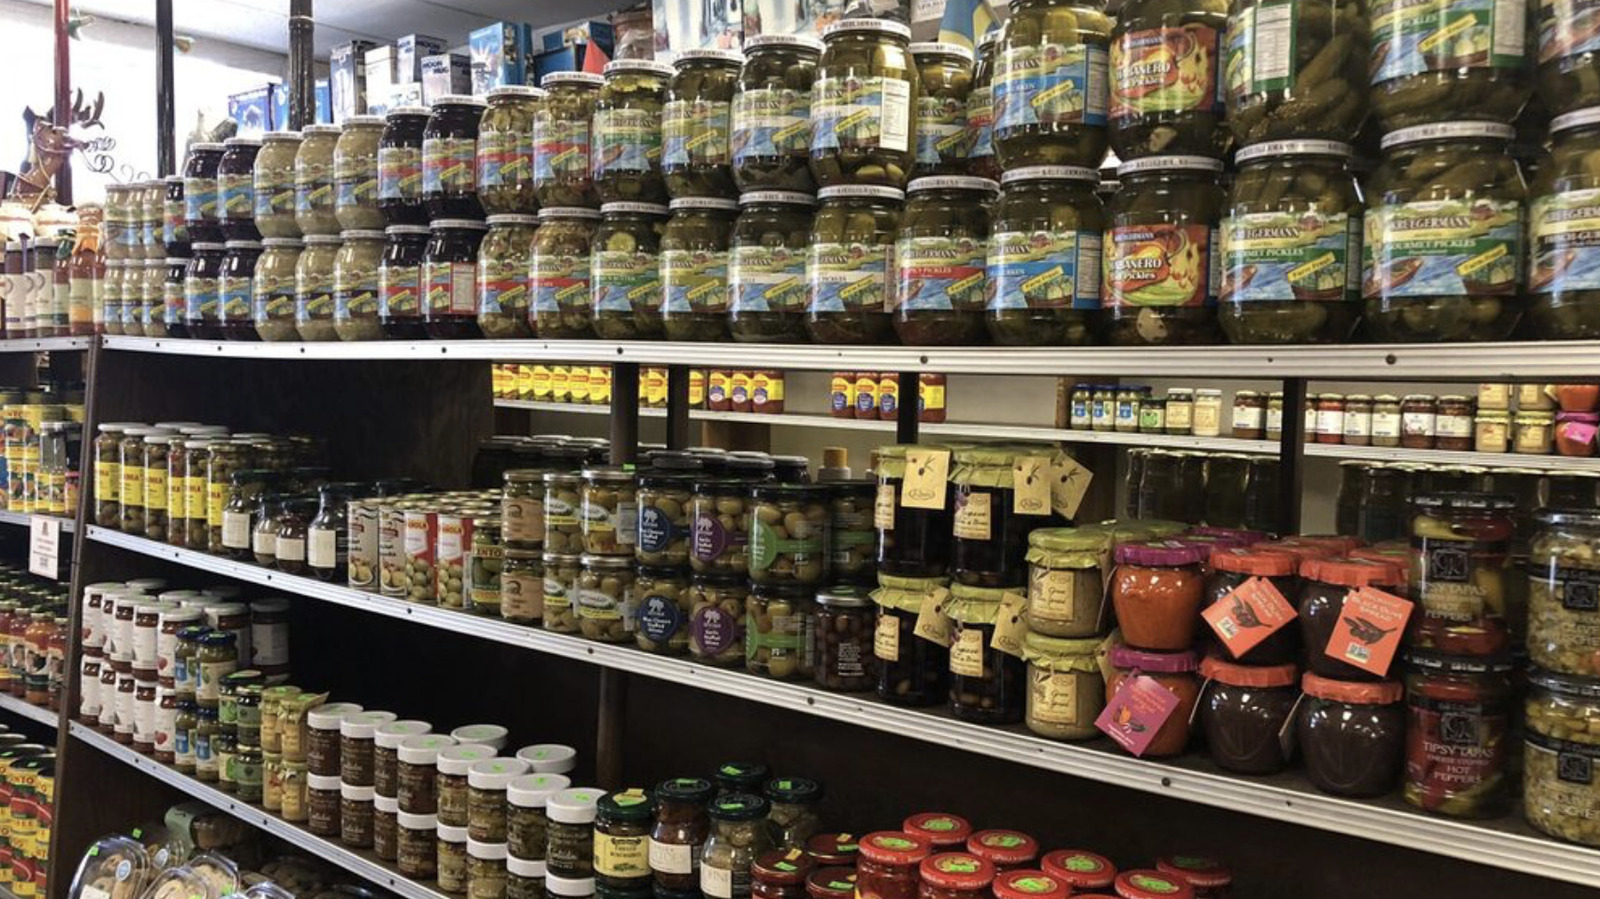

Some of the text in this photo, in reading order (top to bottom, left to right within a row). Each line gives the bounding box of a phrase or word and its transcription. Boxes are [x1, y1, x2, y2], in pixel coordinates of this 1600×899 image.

[1423, 740, 1459, 755] TIPSY
[1446, 766, 1470, 775] HOT
[1434, 772, 1483, 783] PEPPERS
